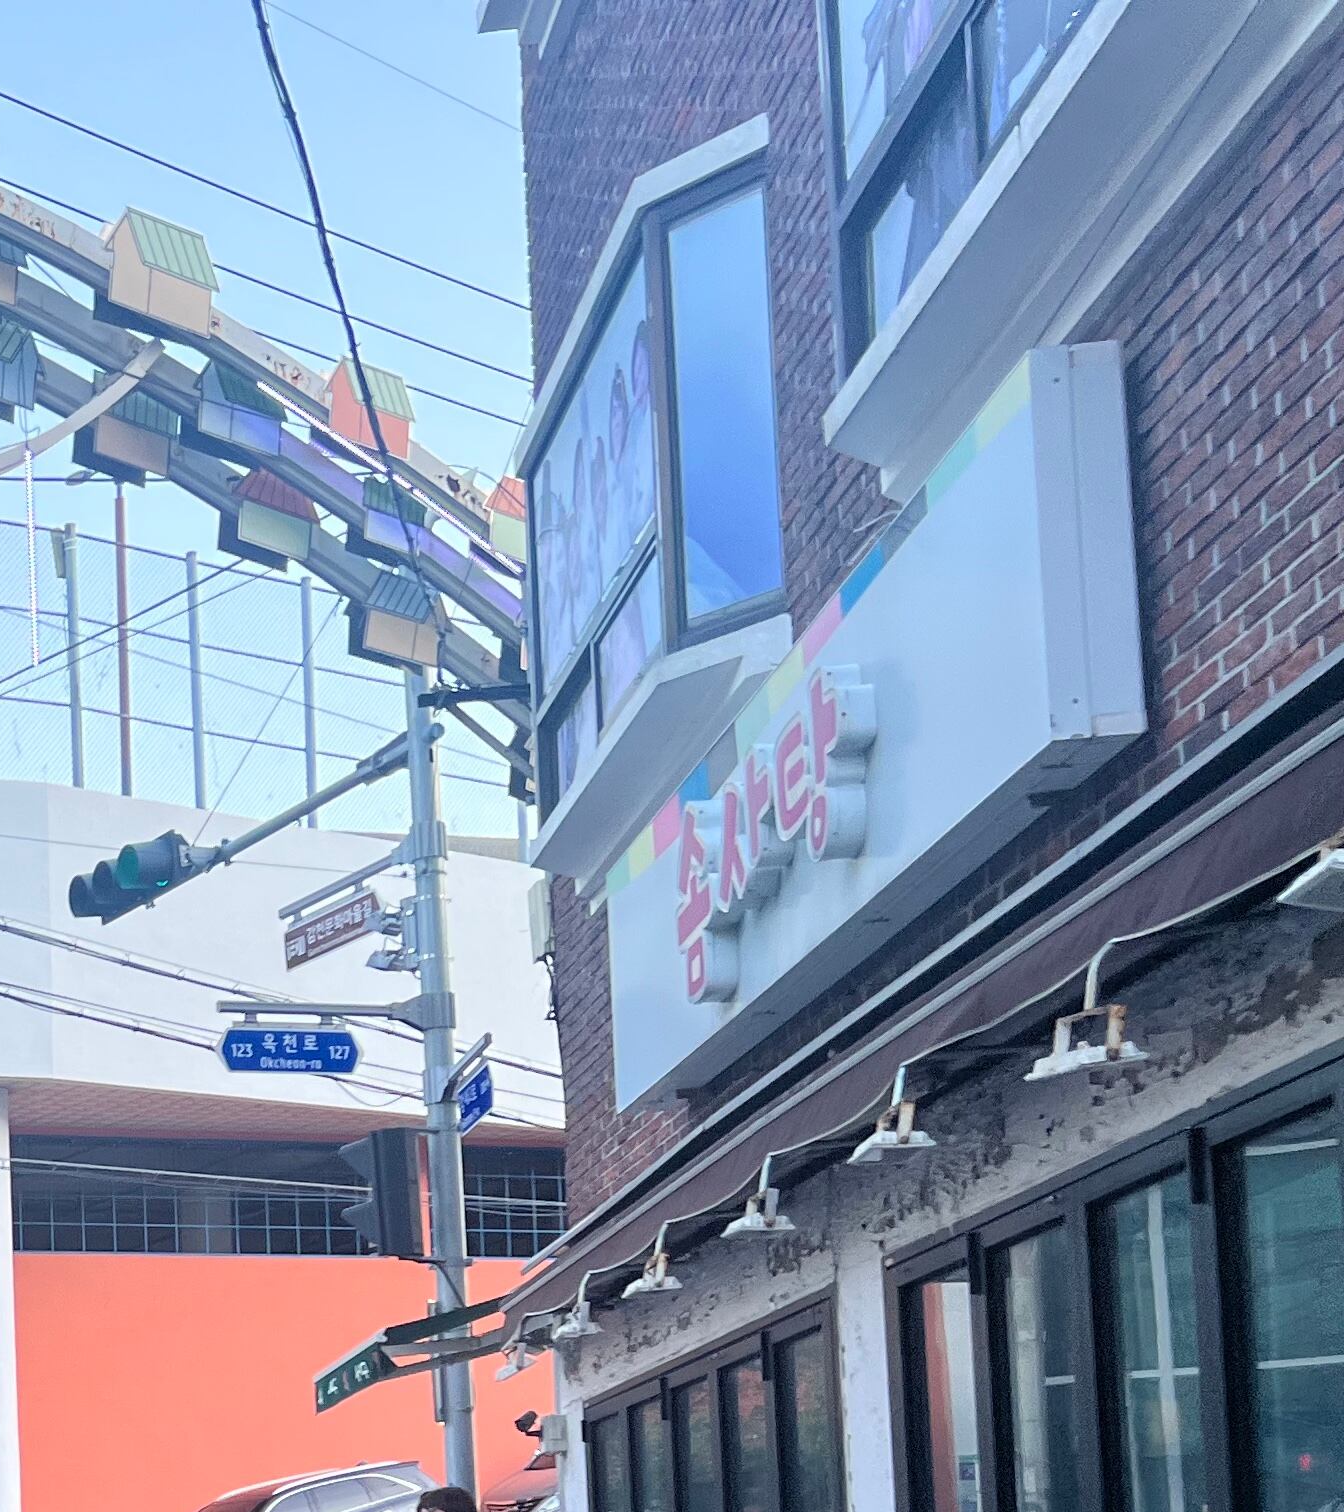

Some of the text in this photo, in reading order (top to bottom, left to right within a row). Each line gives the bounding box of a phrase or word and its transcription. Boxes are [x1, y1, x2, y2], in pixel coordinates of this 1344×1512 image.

[675, 664, 840, 1004] 솜사탕
[231, 1043, 253, 1058] 123
[261, 1033, 319, 1054] 옥천로
[328, 1045, 351, 1060] 127
[259, 1056, 323, 1070] Okcheon-ro
